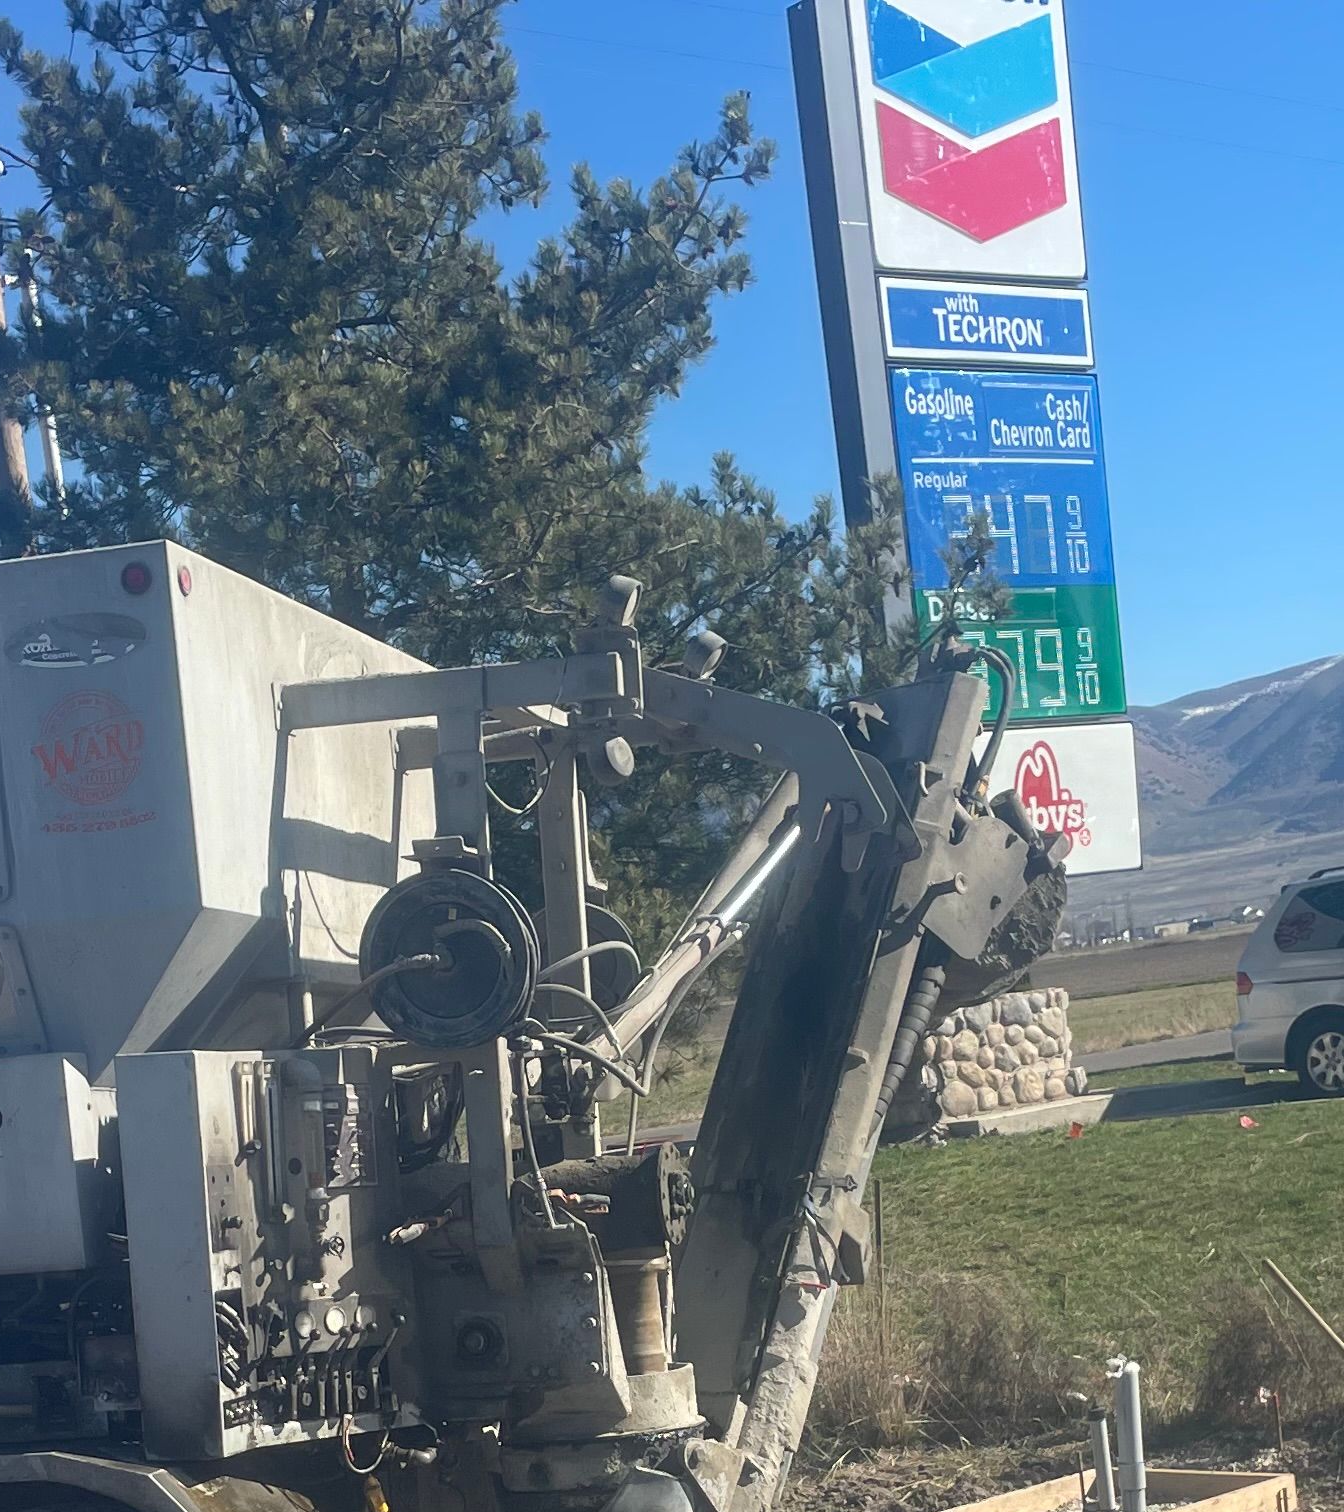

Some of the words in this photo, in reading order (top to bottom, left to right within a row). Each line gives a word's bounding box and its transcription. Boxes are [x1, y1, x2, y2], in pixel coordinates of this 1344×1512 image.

[944, 294, 979, 314] with
[932, 308, 1043, 352] TECHRON
[906, 387, 975, 420] Gasoline
[1046, 392, 1088, 423] Cash/
[990, 418, 1054, 447] Chevron
[1057, 420, 1092, 449] Card
[913, 471, 968, 492] Regular
[31, 720, 144, 784] WARD
